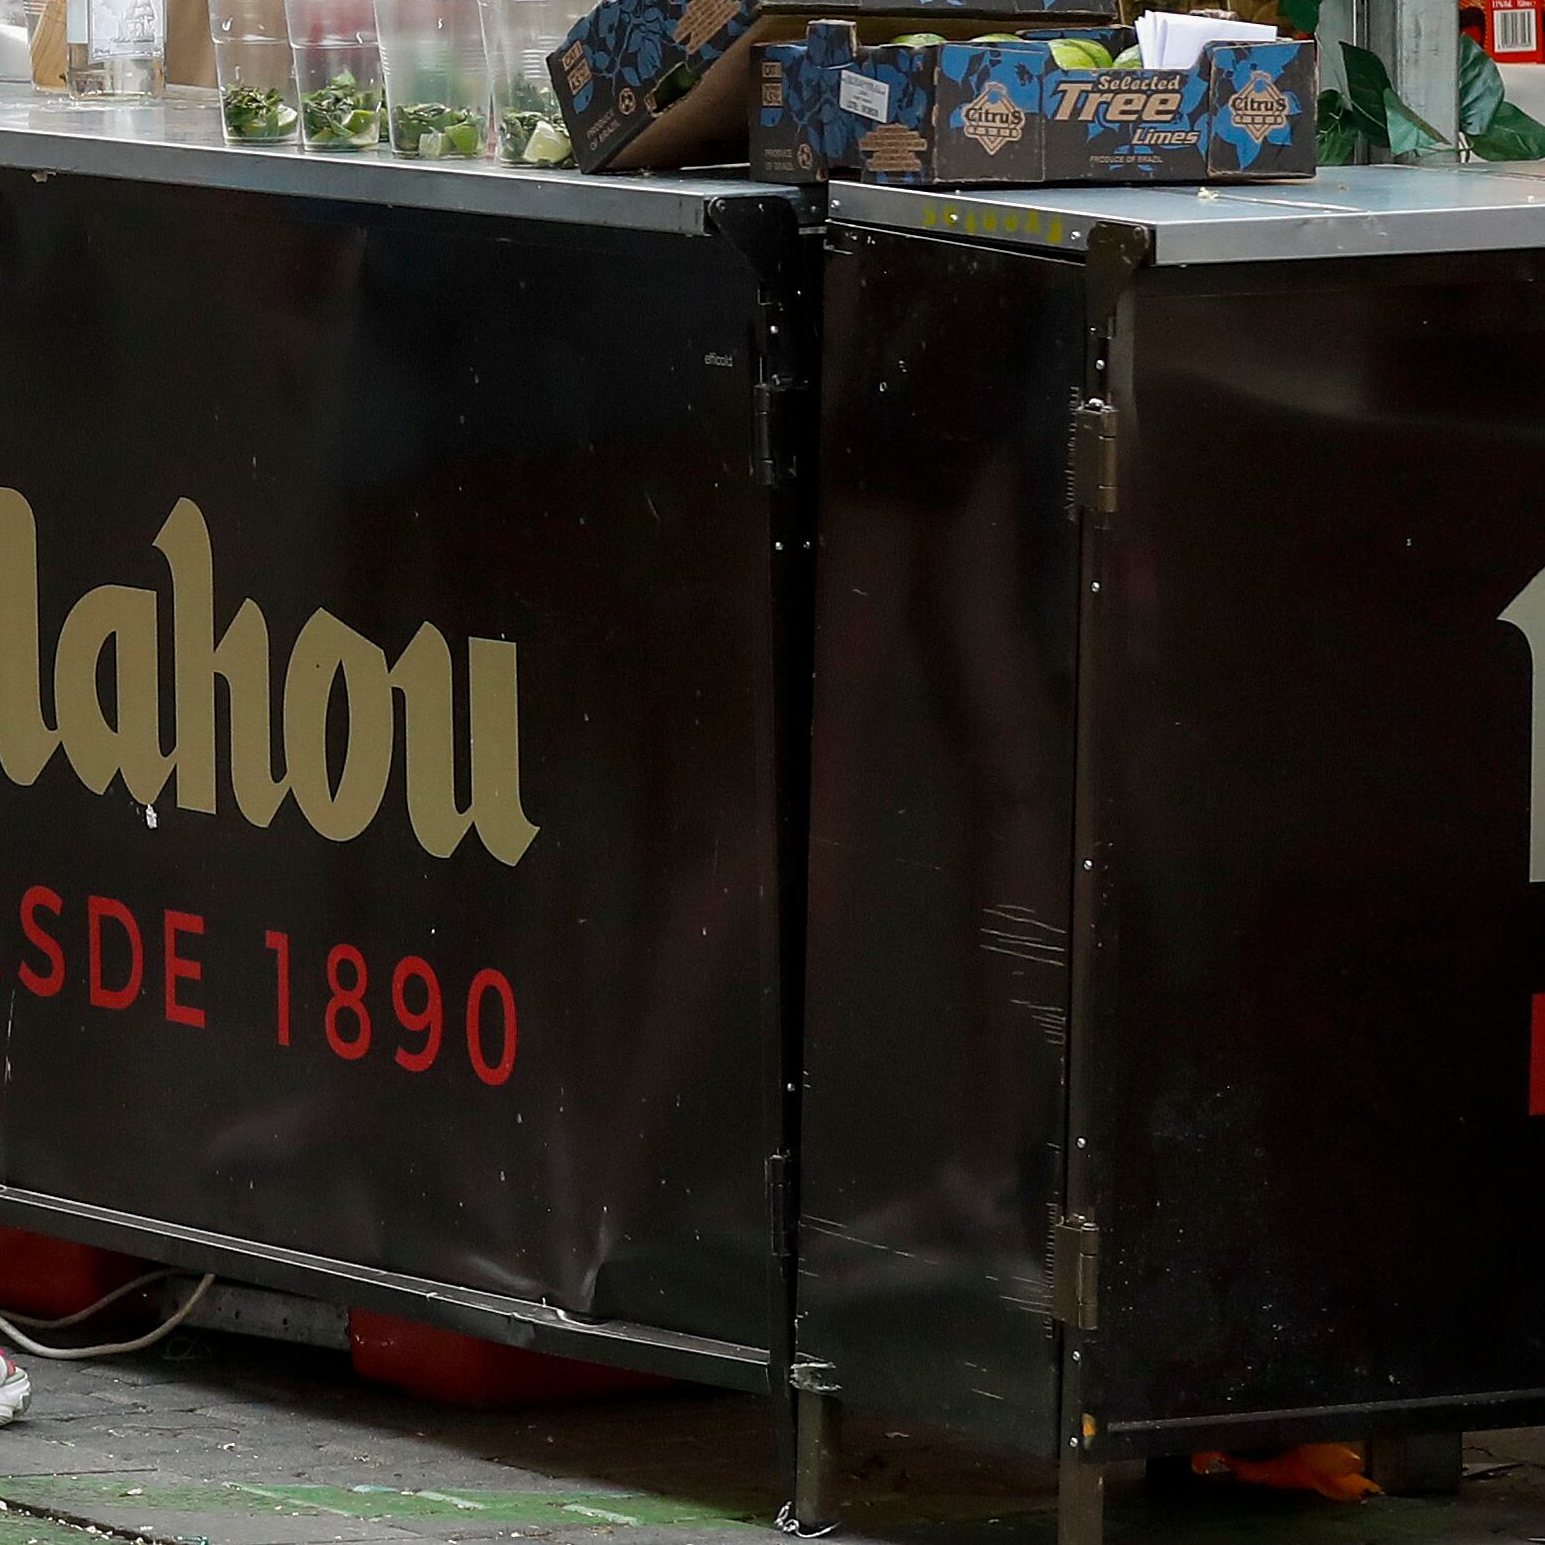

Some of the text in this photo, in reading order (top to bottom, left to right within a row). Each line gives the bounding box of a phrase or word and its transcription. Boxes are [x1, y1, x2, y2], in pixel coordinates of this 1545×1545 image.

[1097, 75, 1181, 92] Selected
[1055, 80, 1183, 123] Tree
[1131, 126, 1200, 146] Limes
[265, 929, 518, 1086] 1890
